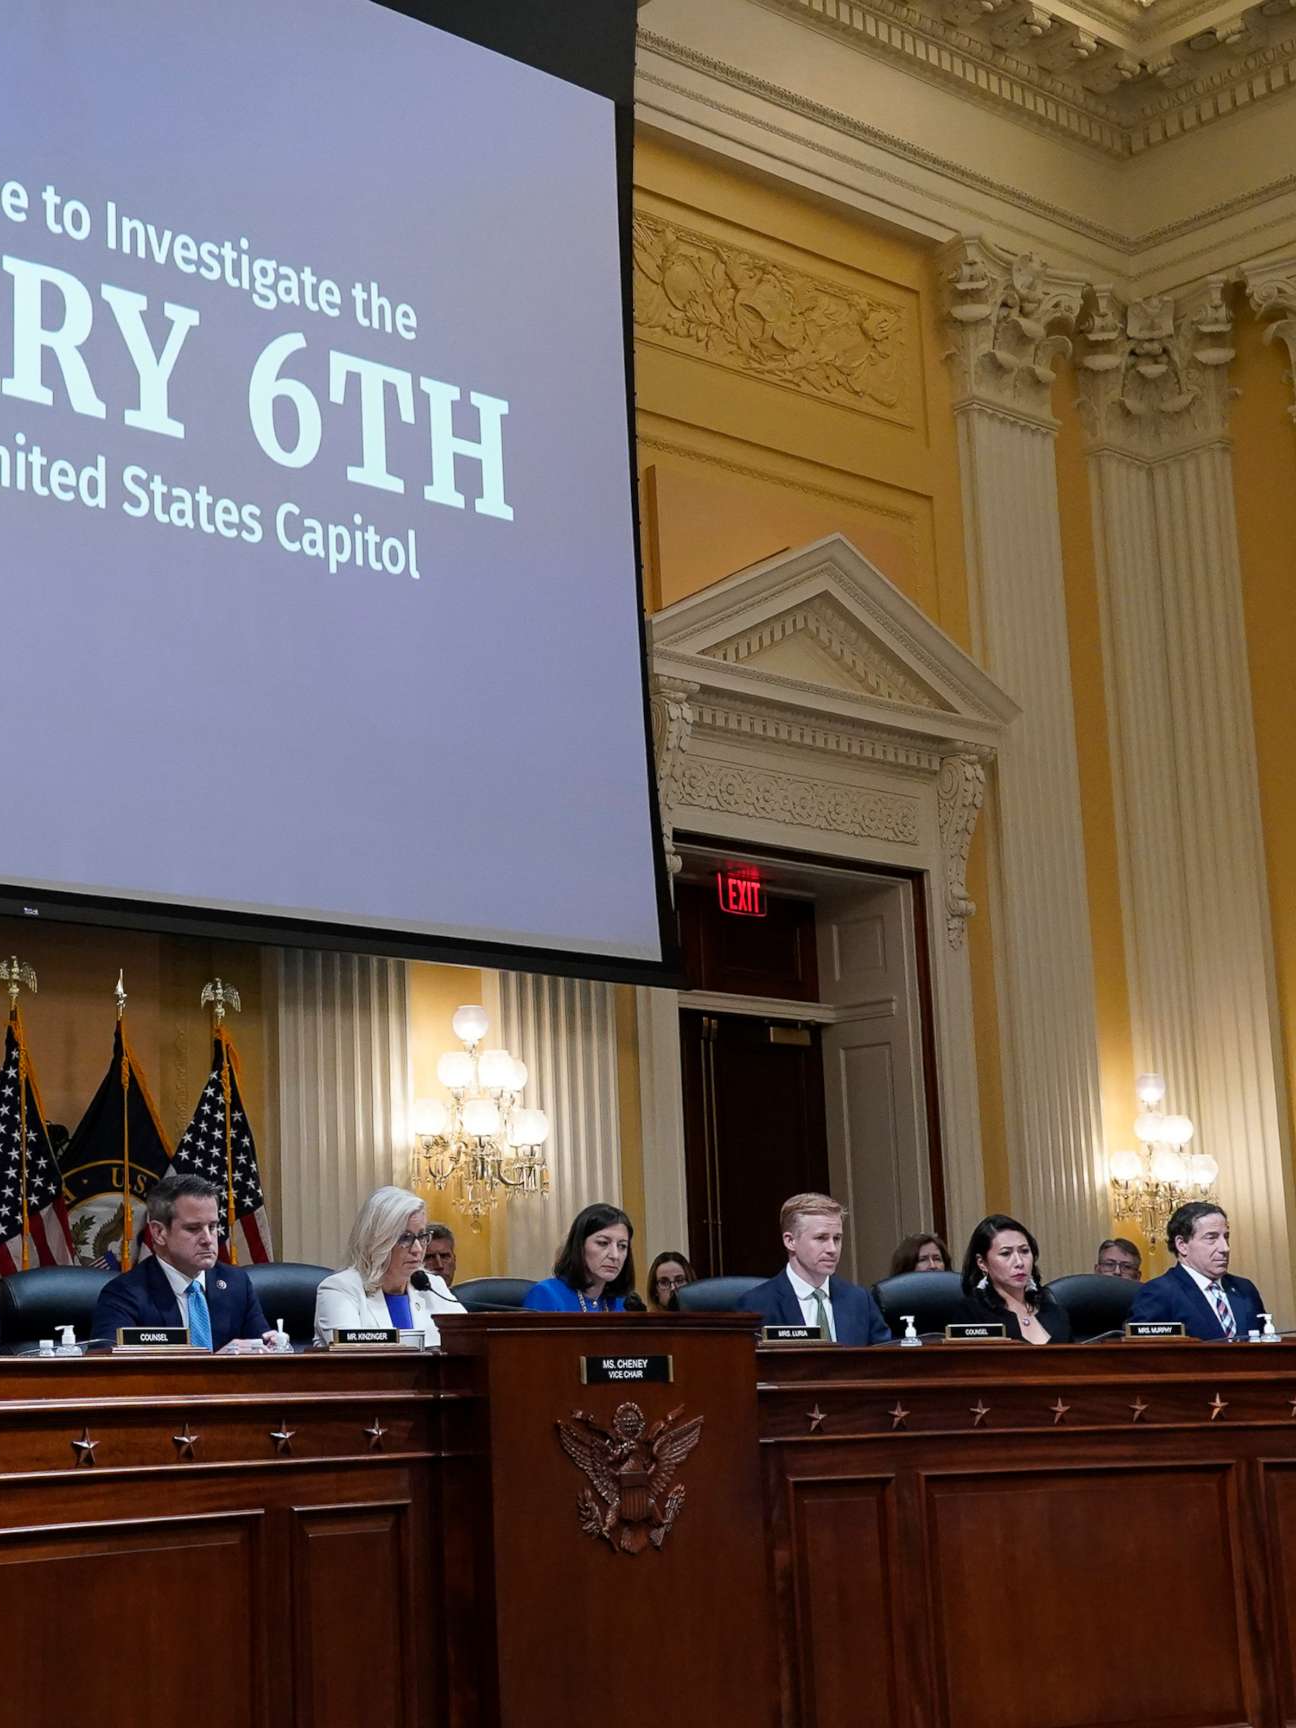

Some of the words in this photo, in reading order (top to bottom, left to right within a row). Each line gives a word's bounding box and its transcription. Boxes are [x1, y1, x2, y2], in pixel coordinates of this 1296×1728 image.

[41, 185, 91, 241] to
[107, 201, 342, 310] Investigate
[351, 282, 417, 340] the
[248, 332, 514, 521] 6TH
[122, 465, 263, 543] States
[276, 503, 420, 580] Capitol
[728, 878, 761, 913] EXIT
[139, 1333, 169, 1342] COUNSEL
[346, 1332, 357, 1341] MR.
[357, 1332, 388, 1340] KINZINGER
[777, 1330, 791, 1338] MRS.
[792, 1329, 809, 1337] LURIA
[602, 1359, 616, 1369] MS.
[616, 1359, 649, 1369] CHENEY
[608, 1371, 623, 1379] VICE
[623, 1370, 644, 1379] CHAIR
